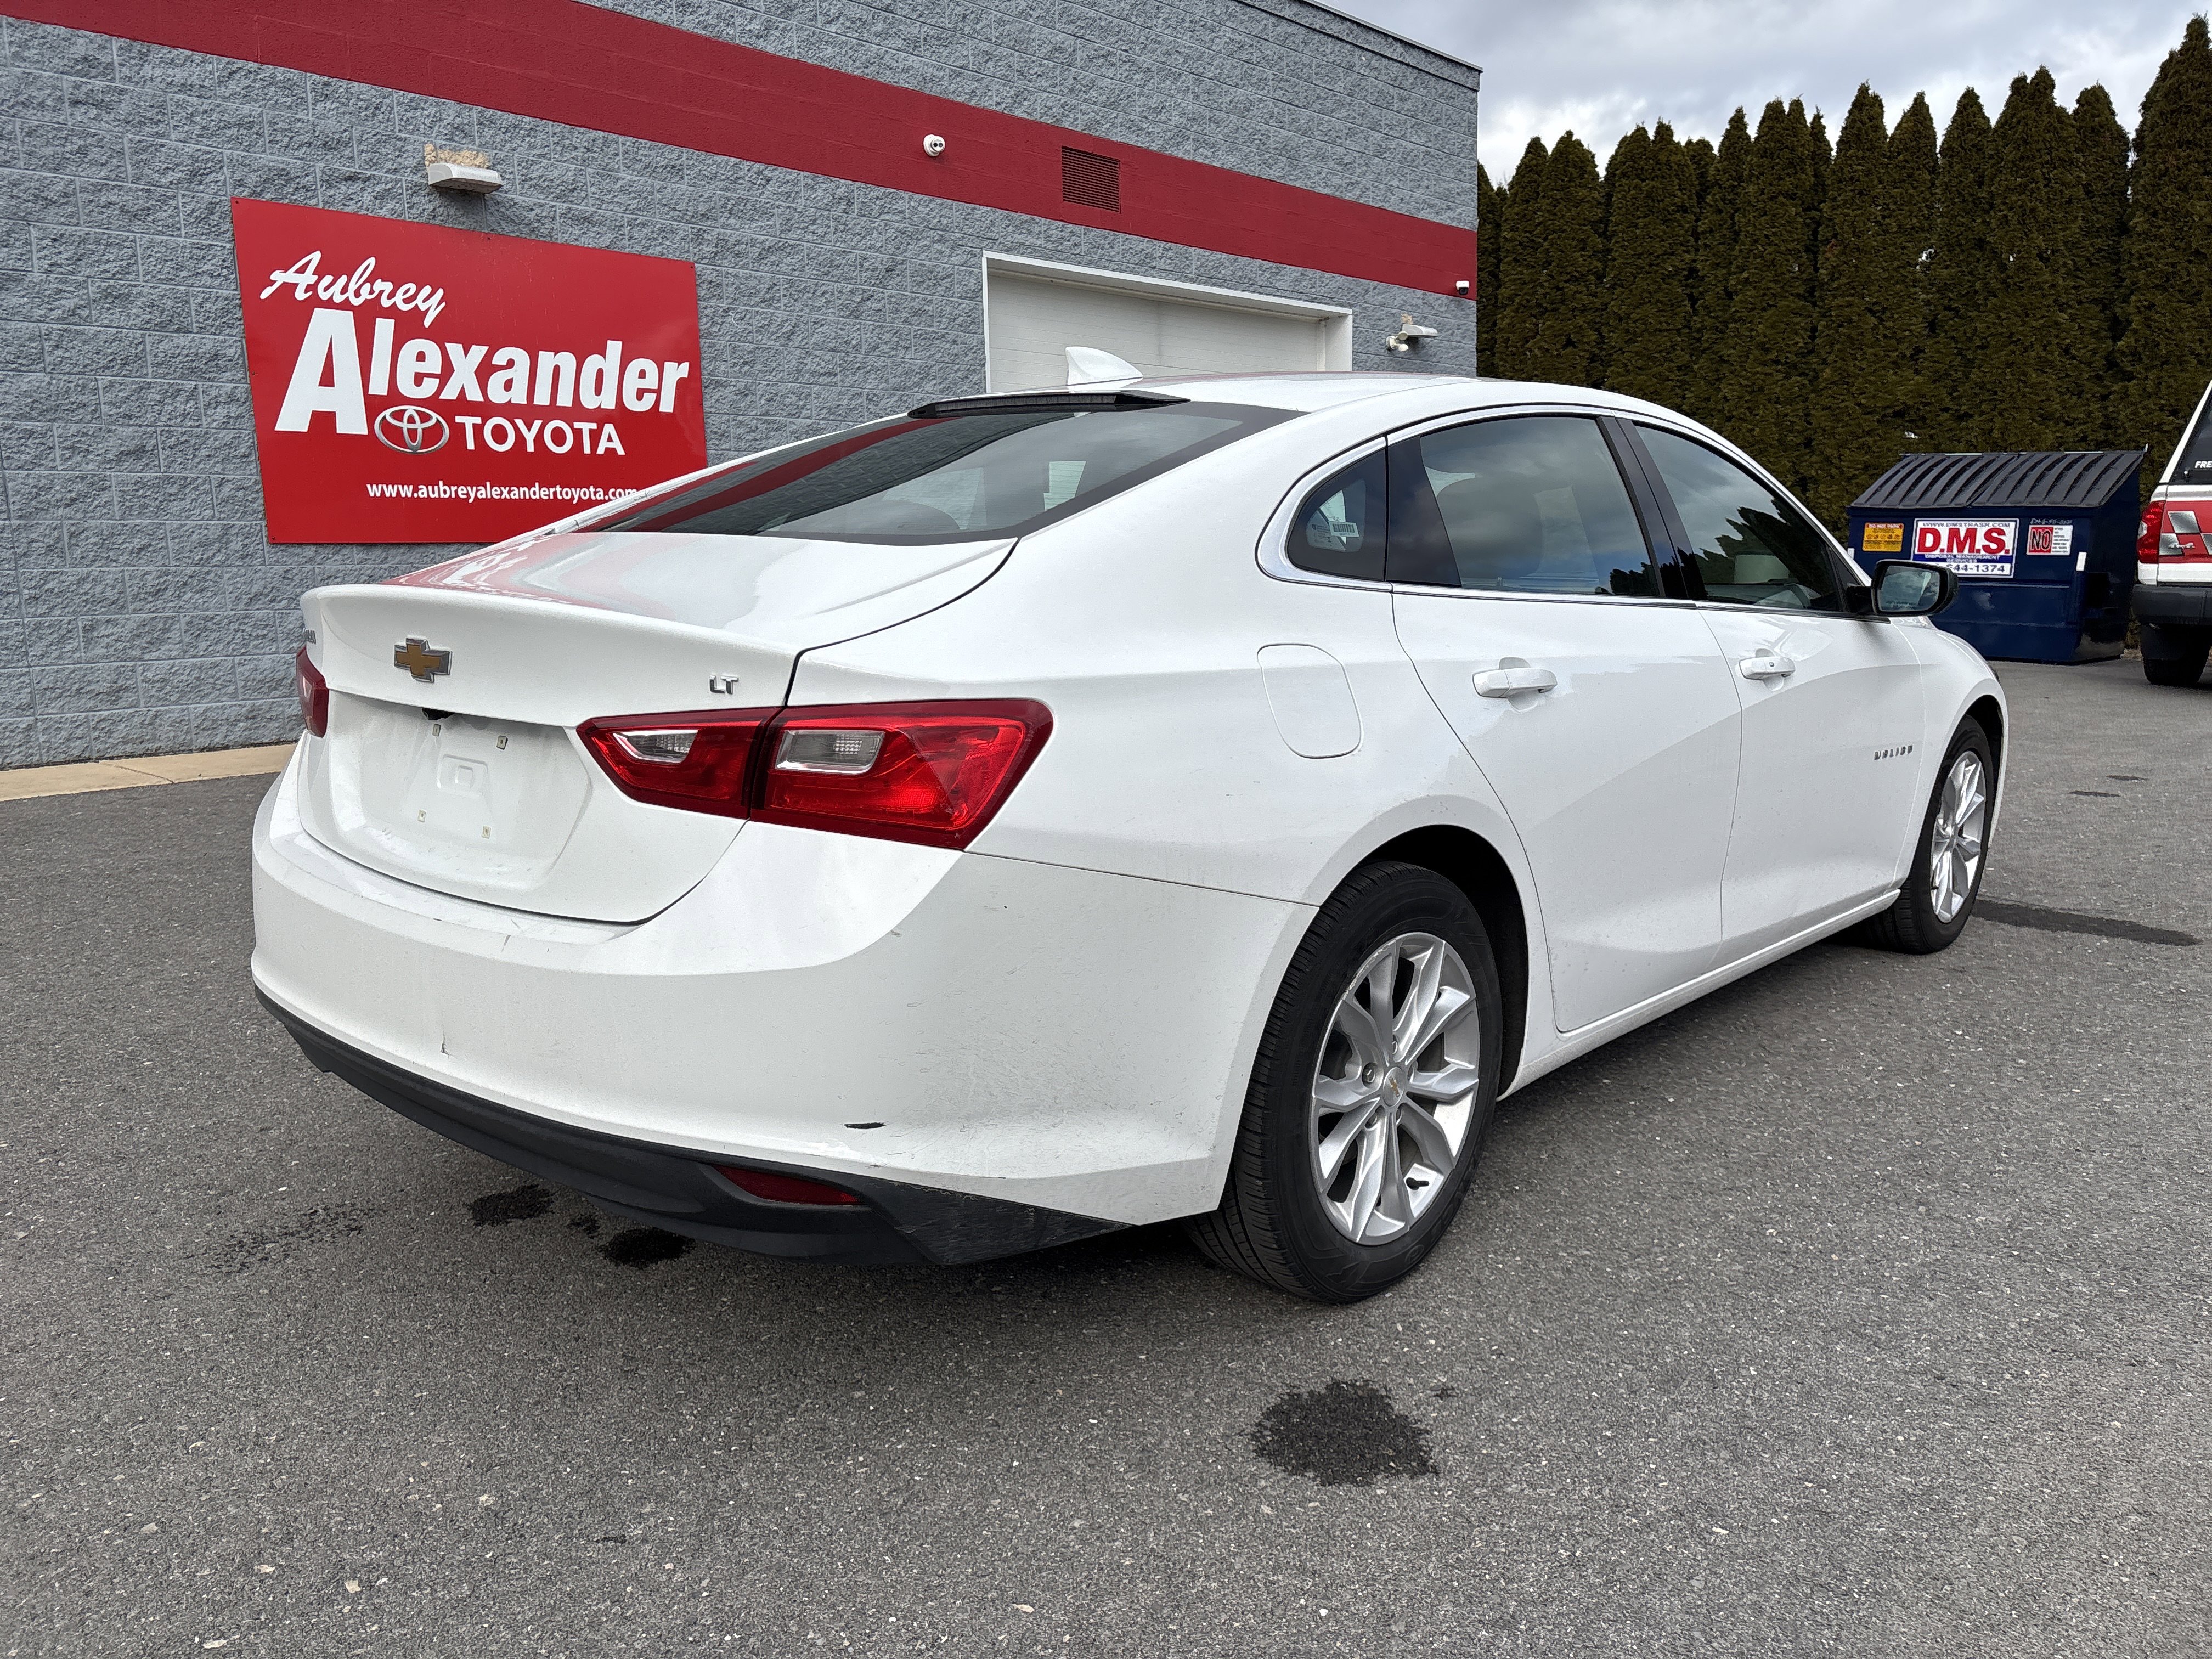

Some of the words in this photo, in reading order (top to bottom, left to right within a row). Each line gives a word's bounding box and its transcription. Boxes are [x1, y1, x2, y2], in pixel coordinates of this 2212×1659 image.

[260, 250, 446, 329] Aubrey
[274, 307, 690, 435] Alexander
[455, 415, 625, 455] TOYOTA
[366, 480, 637, 504] www.aubreyalexandertoyota.com
[1917, 527, 2010, 554] D.M.S.
[2030, 529, 2052, 551] NO
[709, 674, 739, 695] LT
